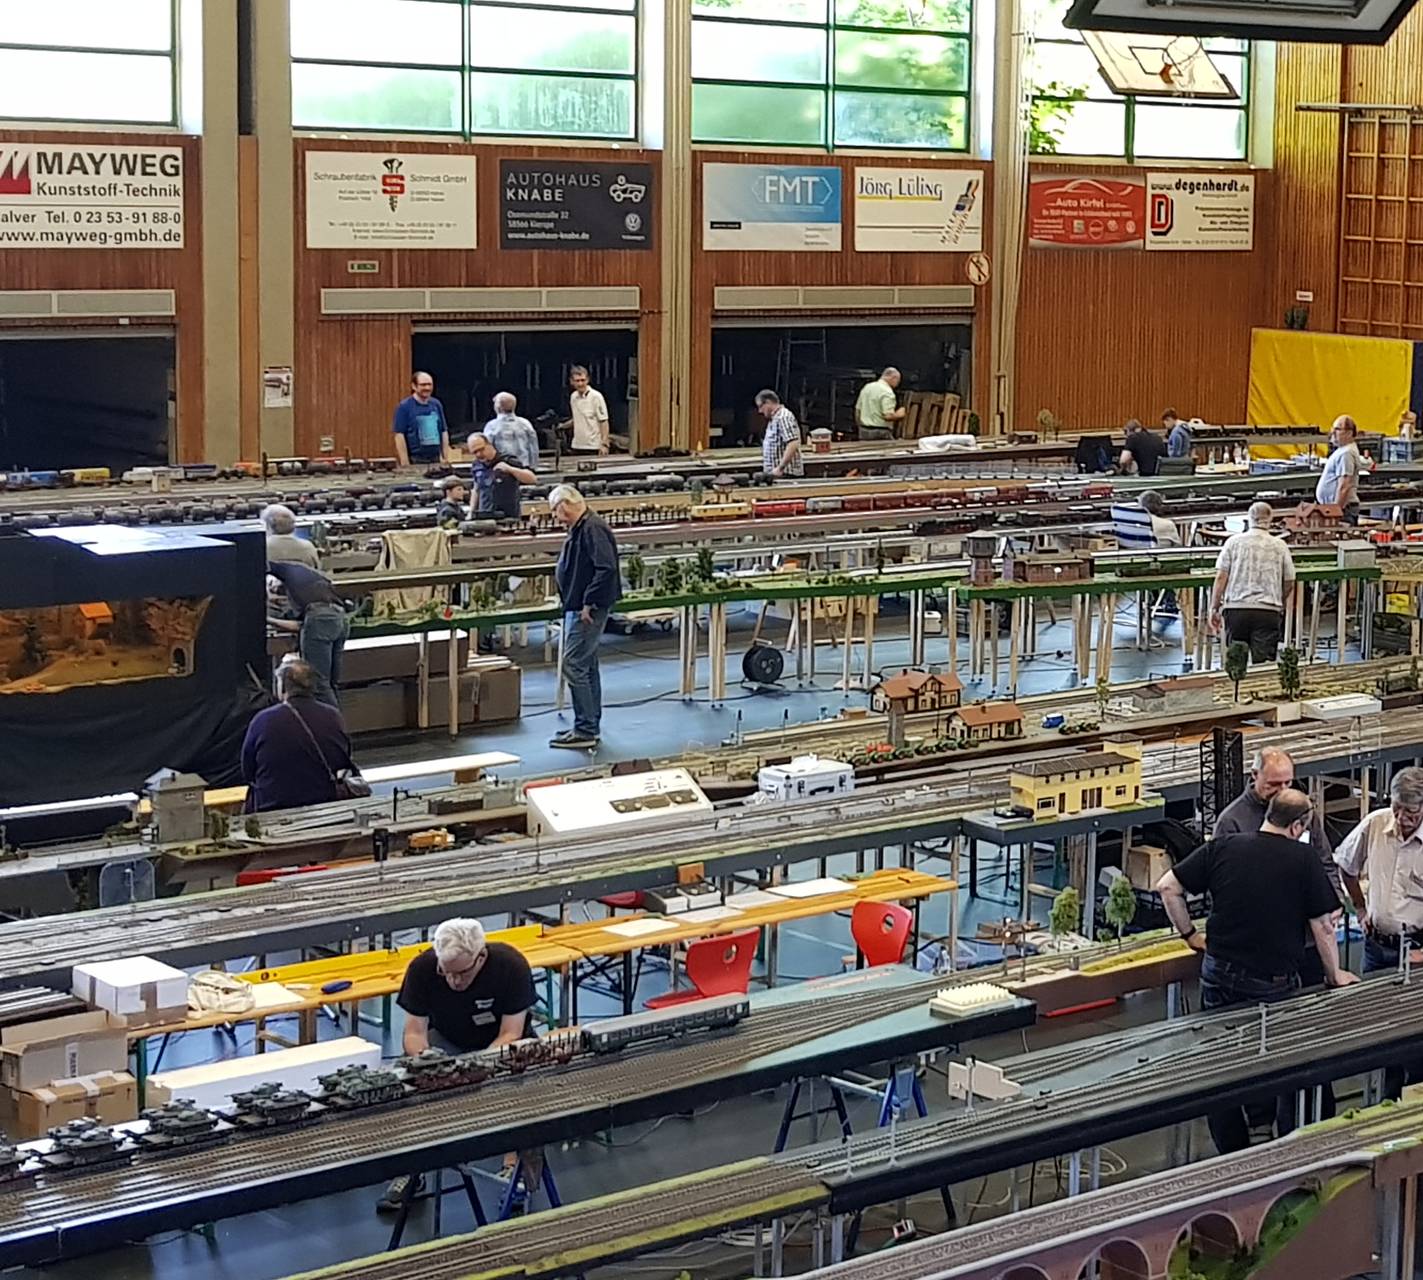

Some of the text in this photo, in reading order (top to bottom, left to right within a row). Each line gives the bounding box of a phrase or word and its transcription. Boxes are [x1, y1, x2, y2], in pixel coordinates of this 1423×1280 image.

[36, 151, 181, 178] MAYWEG
[313, 172, 467, 184] Schraubenfabrik Schmidt GmbH
[506, 172, 601, 187] AUTOHAUS
[36, 182, 181, 199] Kunststoff-Technik
[505, 187, 564, 202] KNABE
[765, 175, 820, 204] FMT
[858, 175, 943, 200] Jörg Lüling
[1150, 178, 1250, 195] www.degenhardt.de
[1055, 197, 1078, 208] Auto
[1079, 197, 1104, 208] Kirfel
[0, 211, 36, 224] alver
[46, 211, 70, 225] Tel.
[73, 211, 82, 225] 0
[86, 212, 102, 225] 23
[152, 212, 181, 225] 88-0
